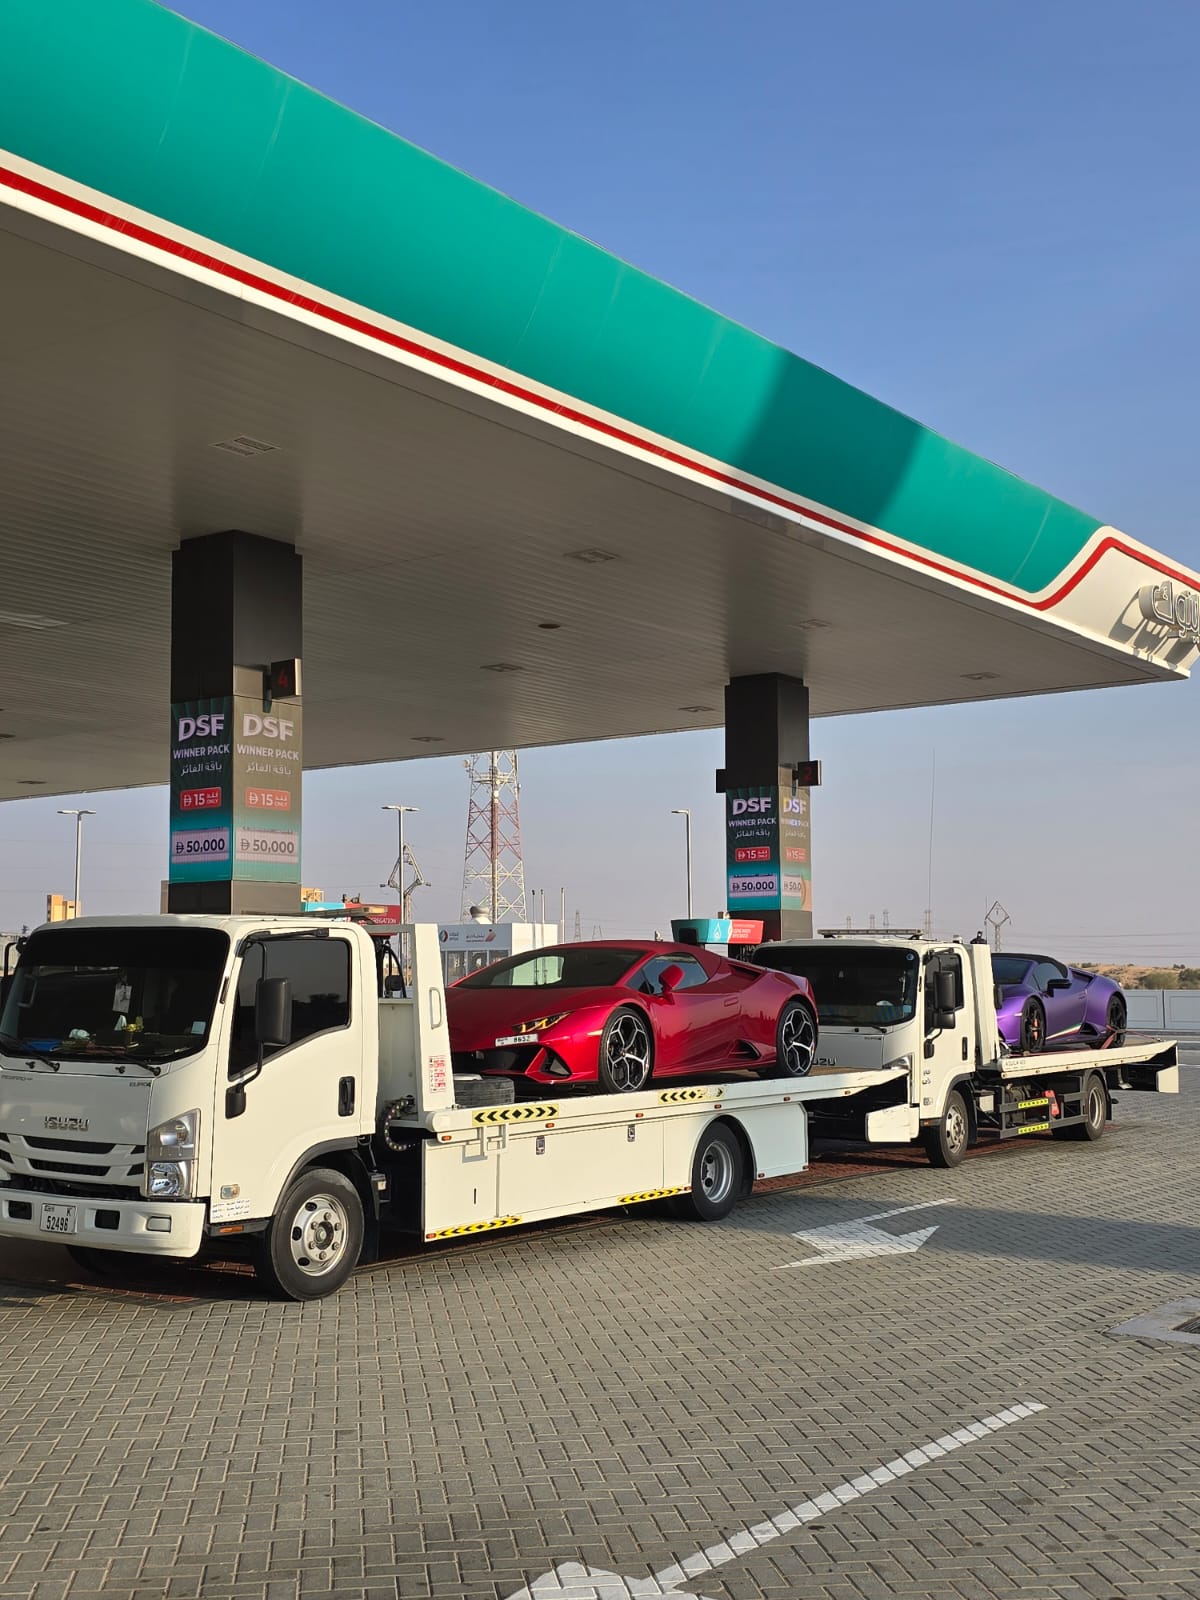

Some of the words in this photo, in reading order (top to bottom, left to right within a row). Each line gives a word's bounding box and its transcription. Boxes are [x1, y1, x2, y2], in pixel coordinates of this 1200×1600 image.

[277, 669, 289, 689] 4
[178, 714, 225, 742] DSF
[243, 713, 294, 741] DSF
[173, 747, 206, 759] WINNER
[207, 743, 230, 755] PACK
[237, 743, 274, 758] WINNER
[275, 749, 299, 761] PACK
[194, 793, 205, 805] 15
[261, 793, 273, 806] 15
[732, 797, 772, 816] DSF
[783, 797, 807, 814] DSF
[729, 819, 756, 827] WINNER
[757, 818, 776, 826] PACK
[186, 839, 225, 853] 50,000
[252, 840, 295, 854] 50,000
[746, 850, 757, 859] 15
[741, 881, 775, 891] 50,000
[44, 1116, 90, 1132] ISUZU
[66, 1207, 73, 1216] K
